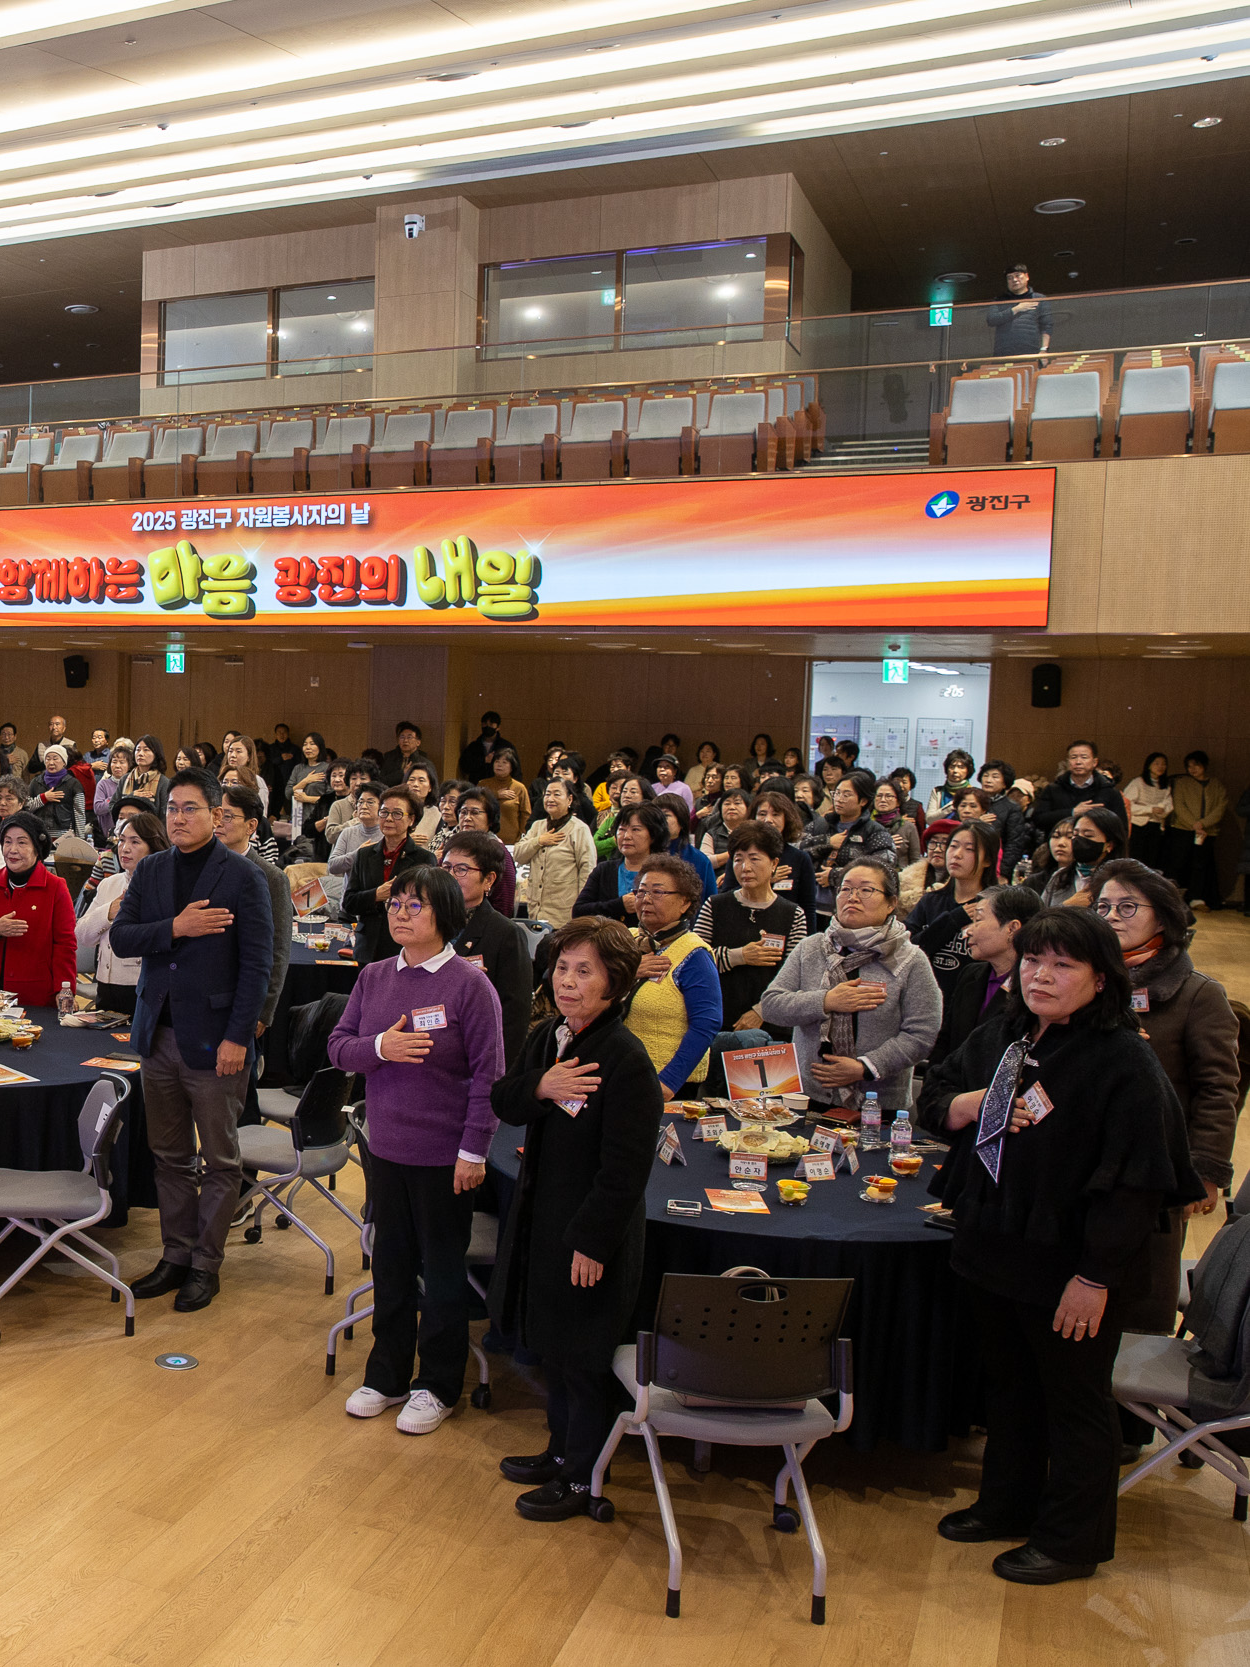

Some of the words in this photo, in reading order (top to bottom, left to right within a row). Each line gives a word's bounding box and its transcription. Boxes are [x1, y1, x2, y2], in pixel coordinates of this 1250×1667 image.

[131, 510, 176, 532] 2025
[180, 508, 232, 530] 광진구
[236, 503, 346, 529] 자원봉사자의
[350, 502, 371, 525] 날
[965, 494, 1031, 512] 광진구
[147, 539, 253, 615] 마음
[274, 553, 399, 603] 광진의
[413, 535, 535, 618] 내일
[302, 890, 311, 908] 7
[753, 1059, 768, 1088] 1
